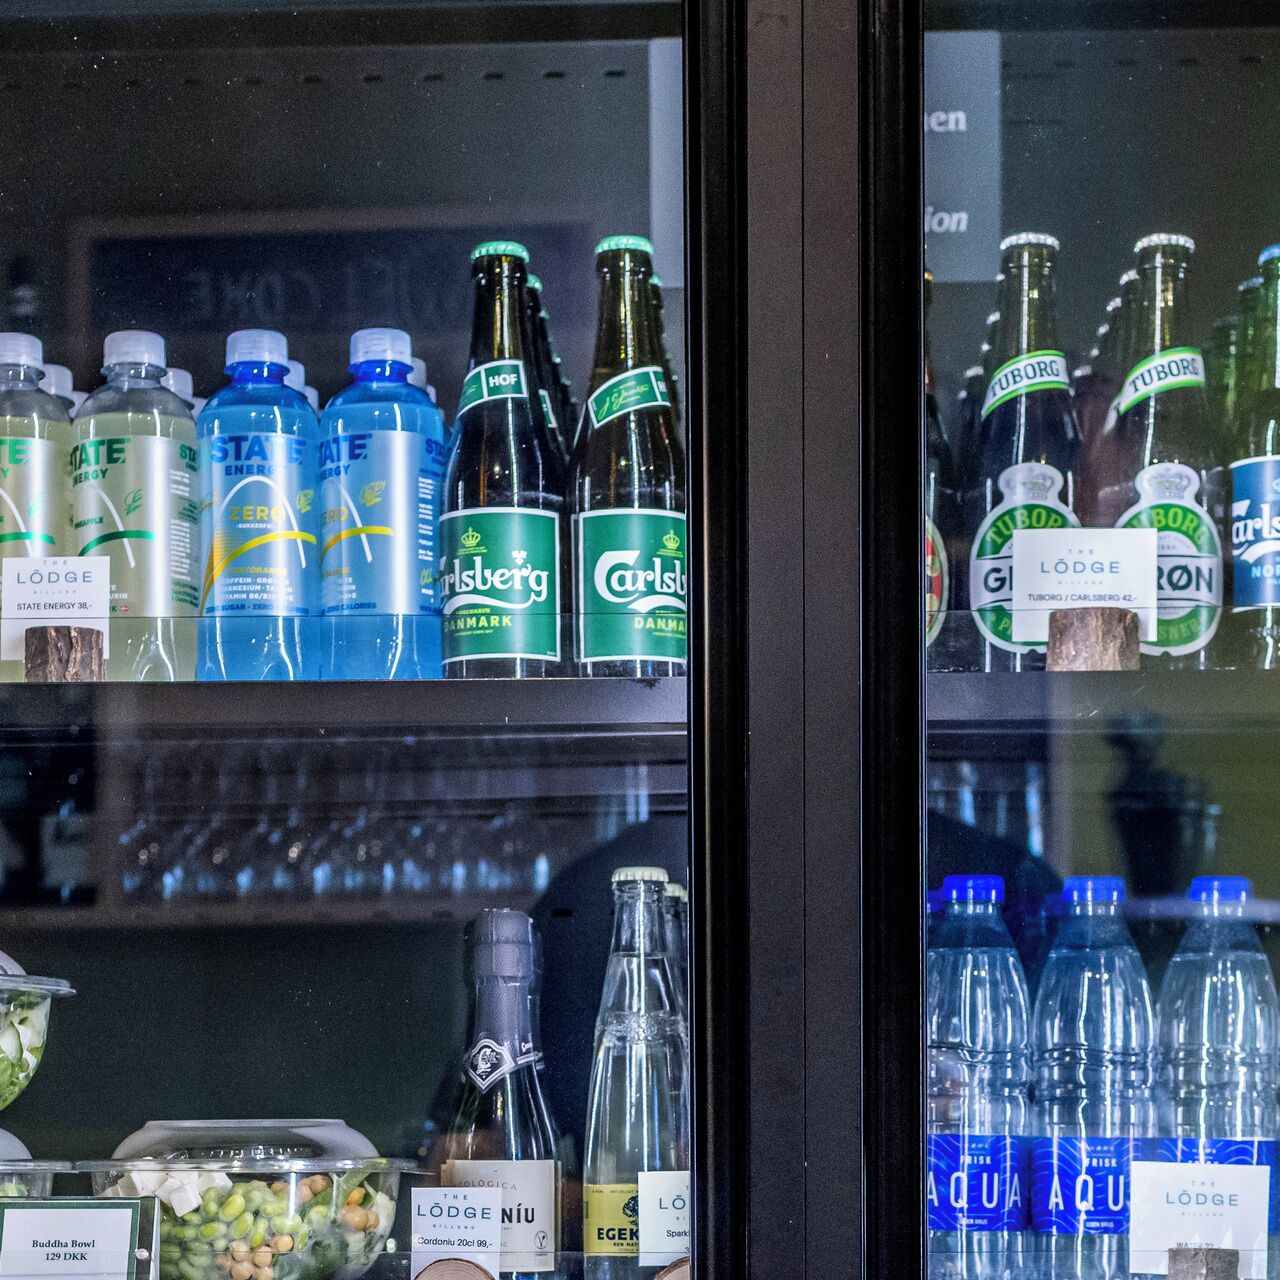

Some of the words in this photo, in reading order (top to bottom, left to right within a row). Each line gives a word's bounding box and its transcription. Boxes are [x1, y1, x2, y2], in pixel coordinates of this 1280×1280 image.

[489, 374, 517, 387] HOF
[990, 359, 1061, 398] TUBORG
[1129, 358, 1199, 394] TUBORG
[230, 506, 286, 521] ZERO
[1028, 593, 1063, 601] TUBORG
[1071, 593, 1120, 602] CARLSBERG
[17, 602, 41, 611] STATE
[43, 602, 75, 611] ENERGY
[77, 602, 93, 611] 38,-
[960, 1155, 991, 1165] FRISK
[928, 1172, 1021, 1209] AQUA
[1049, 1174, 1126, 1211] AQU
[1166, 1189, 1238, 1207] LŌDGE
[417, 1202, 492, 1219] LŌDGE
[32, 1239, 68, 1248] Buddha
[71, 1239, 96, 1248] Bowl
[418, 1236, 455, 1246] Cordoniu
[458, 1238, 475, 1247] 20cl
[477, 1239, 493, 1248] 99,-
[45, 1252, 61, 1261] 129
[63, 1252, 88, 1261] DKK
